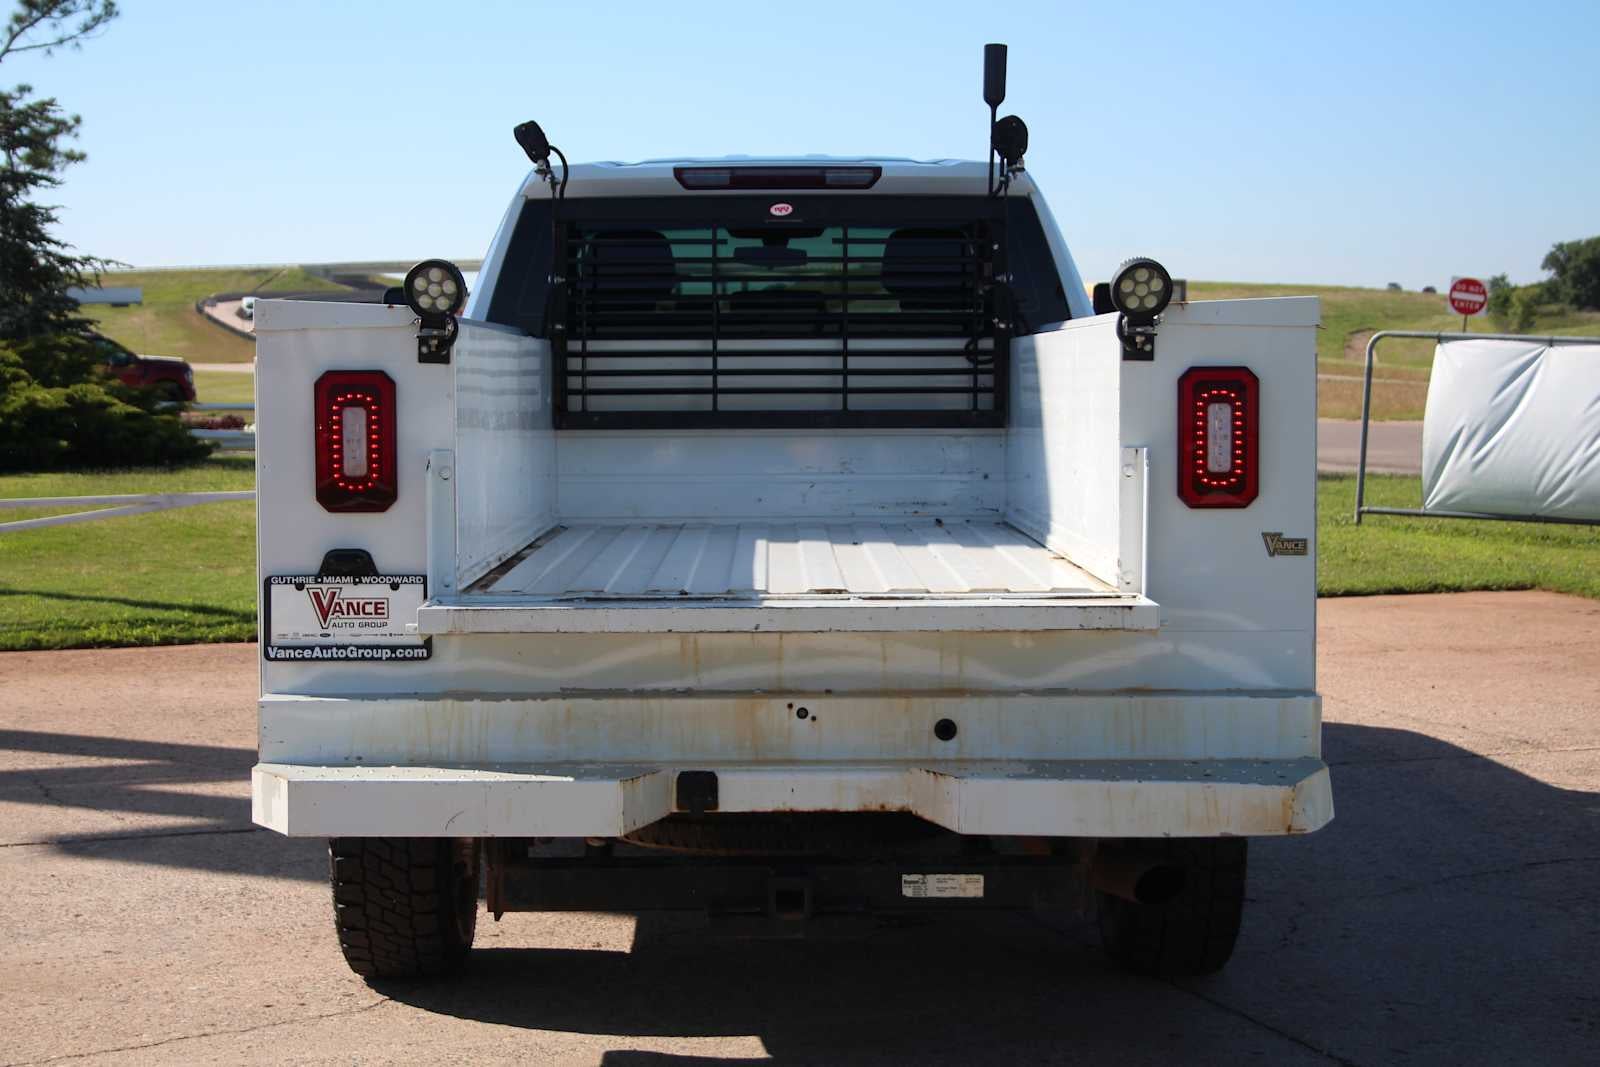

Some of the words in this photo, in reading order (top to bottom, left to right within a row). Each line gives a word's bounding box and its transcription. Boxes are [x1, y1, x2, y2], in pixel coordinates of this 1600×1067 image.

[1454, 300, 1481, 309] ENTER
[1262, 533, 1306, 555] VANCE
[271, 576, 316, 584] GUTHRIE
[322, 576, 354, 584] MIAMI
[361, 576, 424, 584] WOODWARD
[310, 590, 387, 626] VANCE
[267, 646, 428, 660] VanceAutoGroup.com
